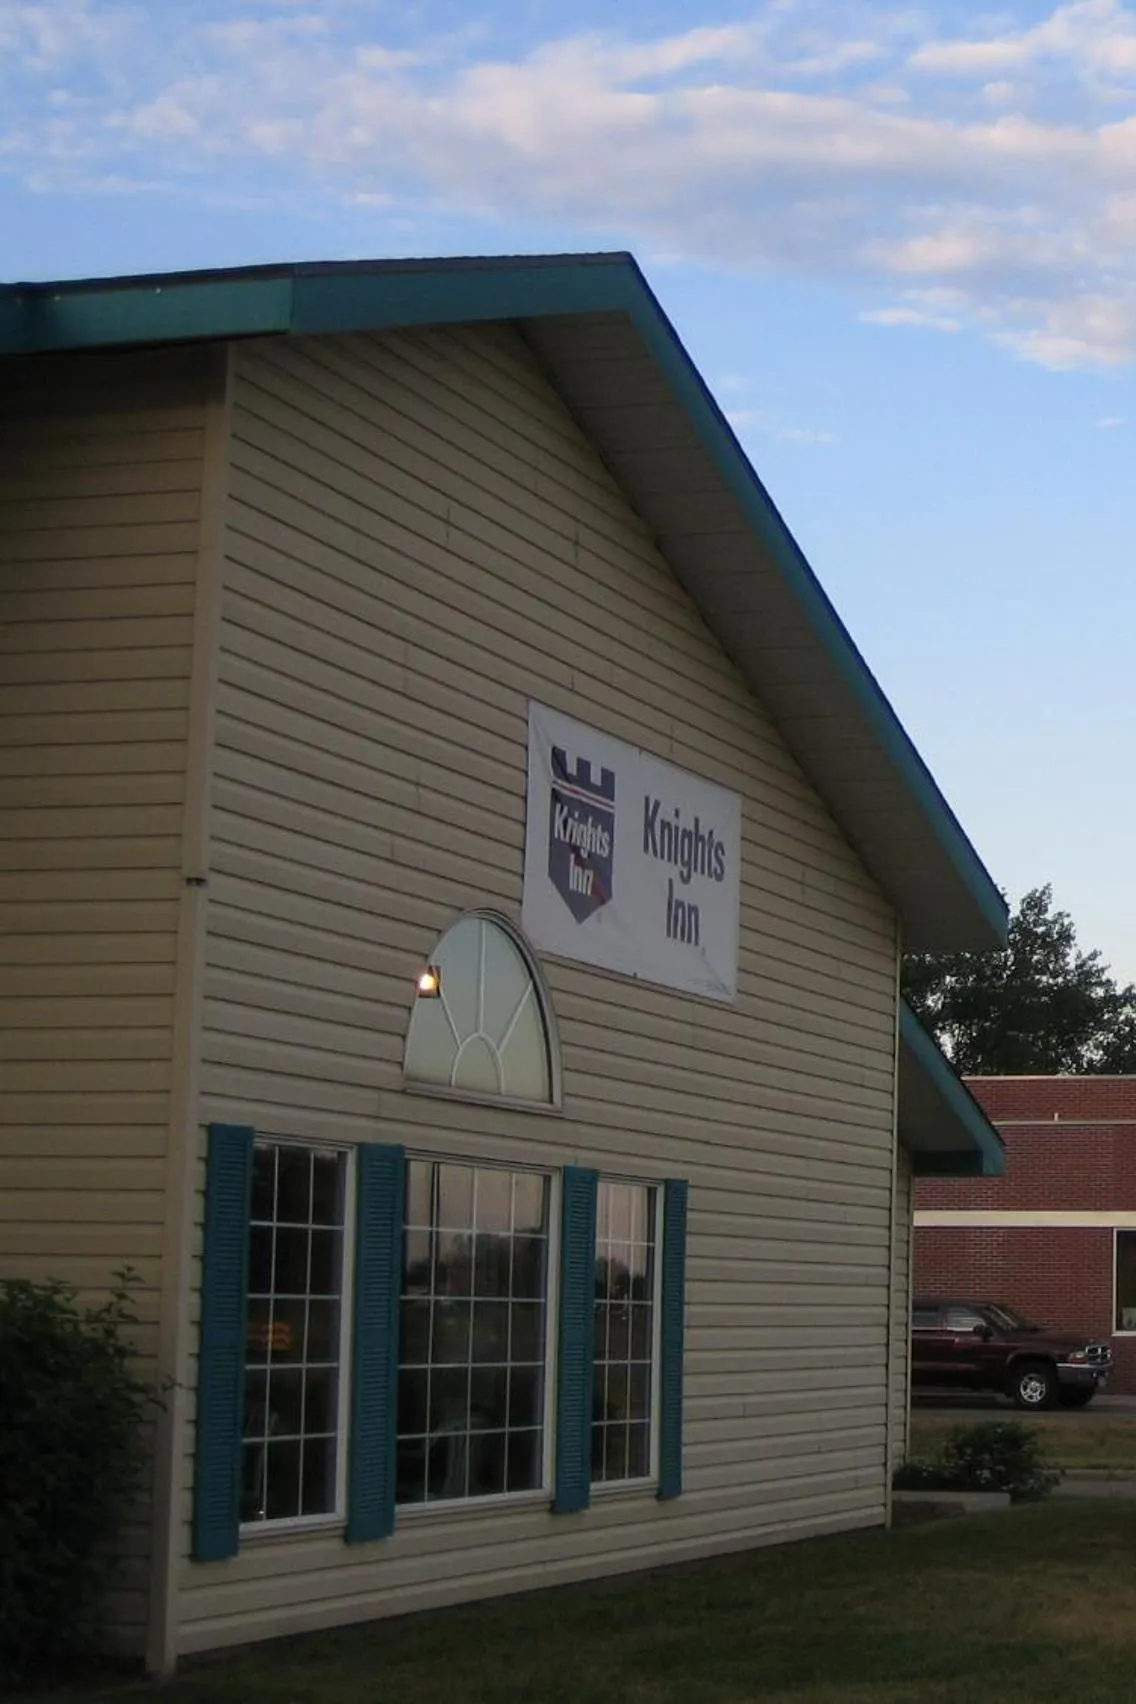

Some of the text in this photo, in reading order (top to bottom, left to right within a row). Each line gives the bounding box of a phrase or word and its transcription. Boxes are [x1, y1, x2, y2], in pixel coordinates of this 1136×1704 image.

[554, 803, 611, 858] Knights
[643, 796, 726, 885] Knights
[569, 853, 594, 896] Inn
[667, 878, 700, 946] Inn
